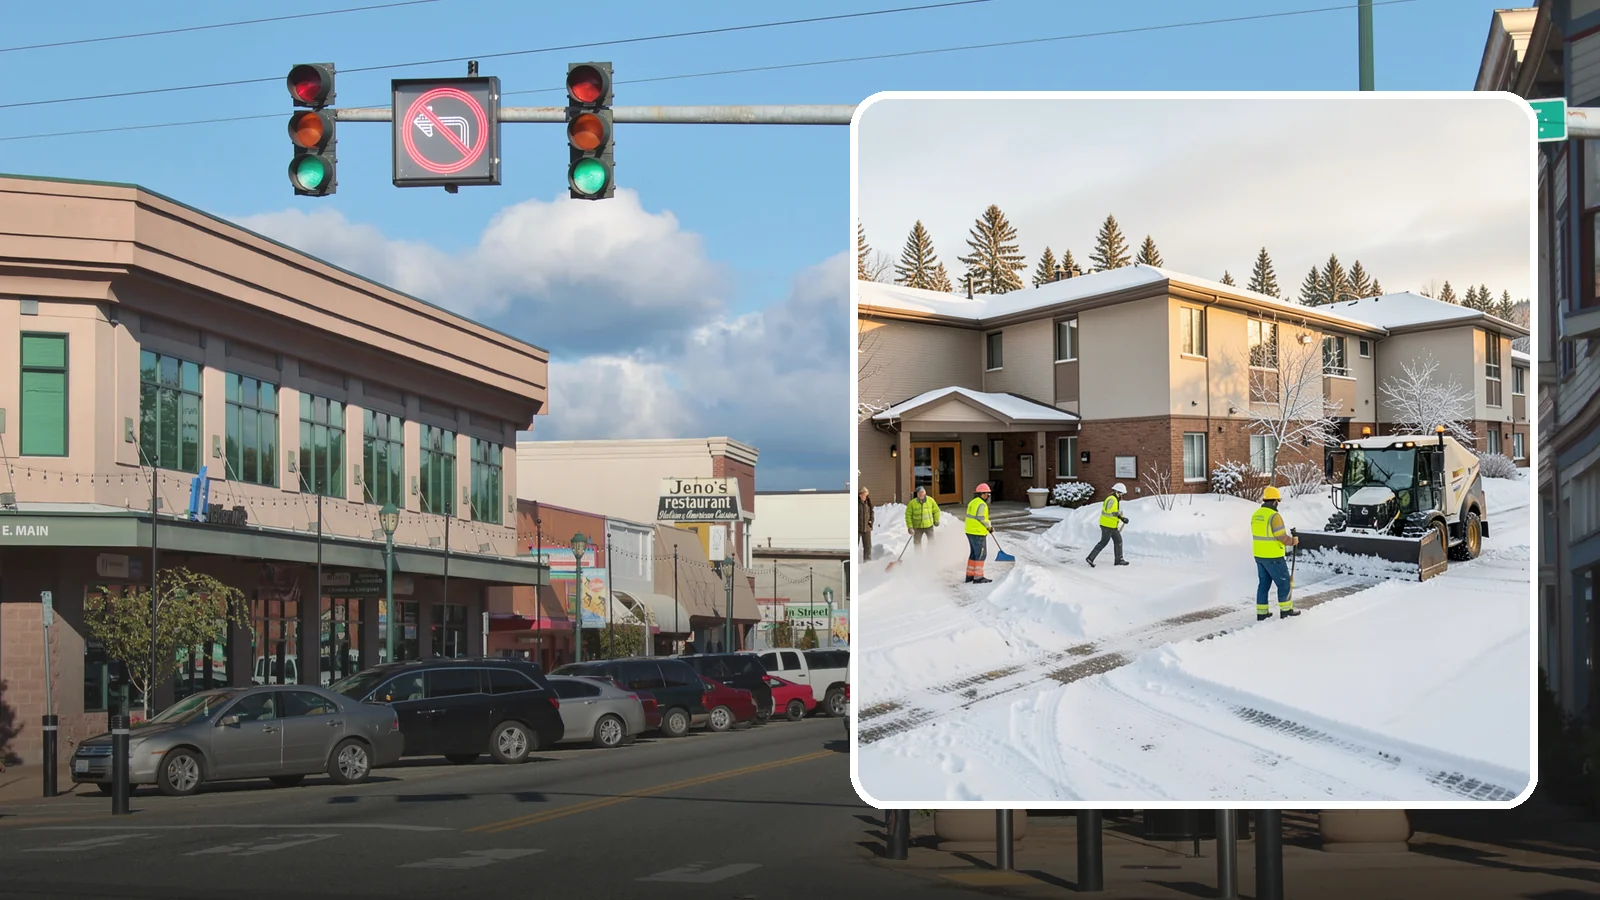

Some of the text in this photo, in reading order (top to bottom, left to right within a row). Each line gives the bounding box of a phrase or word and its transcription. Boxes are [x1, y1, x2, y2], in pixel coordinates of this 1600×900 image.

[670, 480, 728, 494] Jeno's
[665, 496, 731, 509] restaurant
[659, 510, 681, 520] Italian
[686, 510, 715, 519] American
[715, 509, 737, 519] Cuisine
[2, 525, 49, 537] E. MAIN
[797, 607, 829, 617] Street
[790, 619, 823, 627] lass
